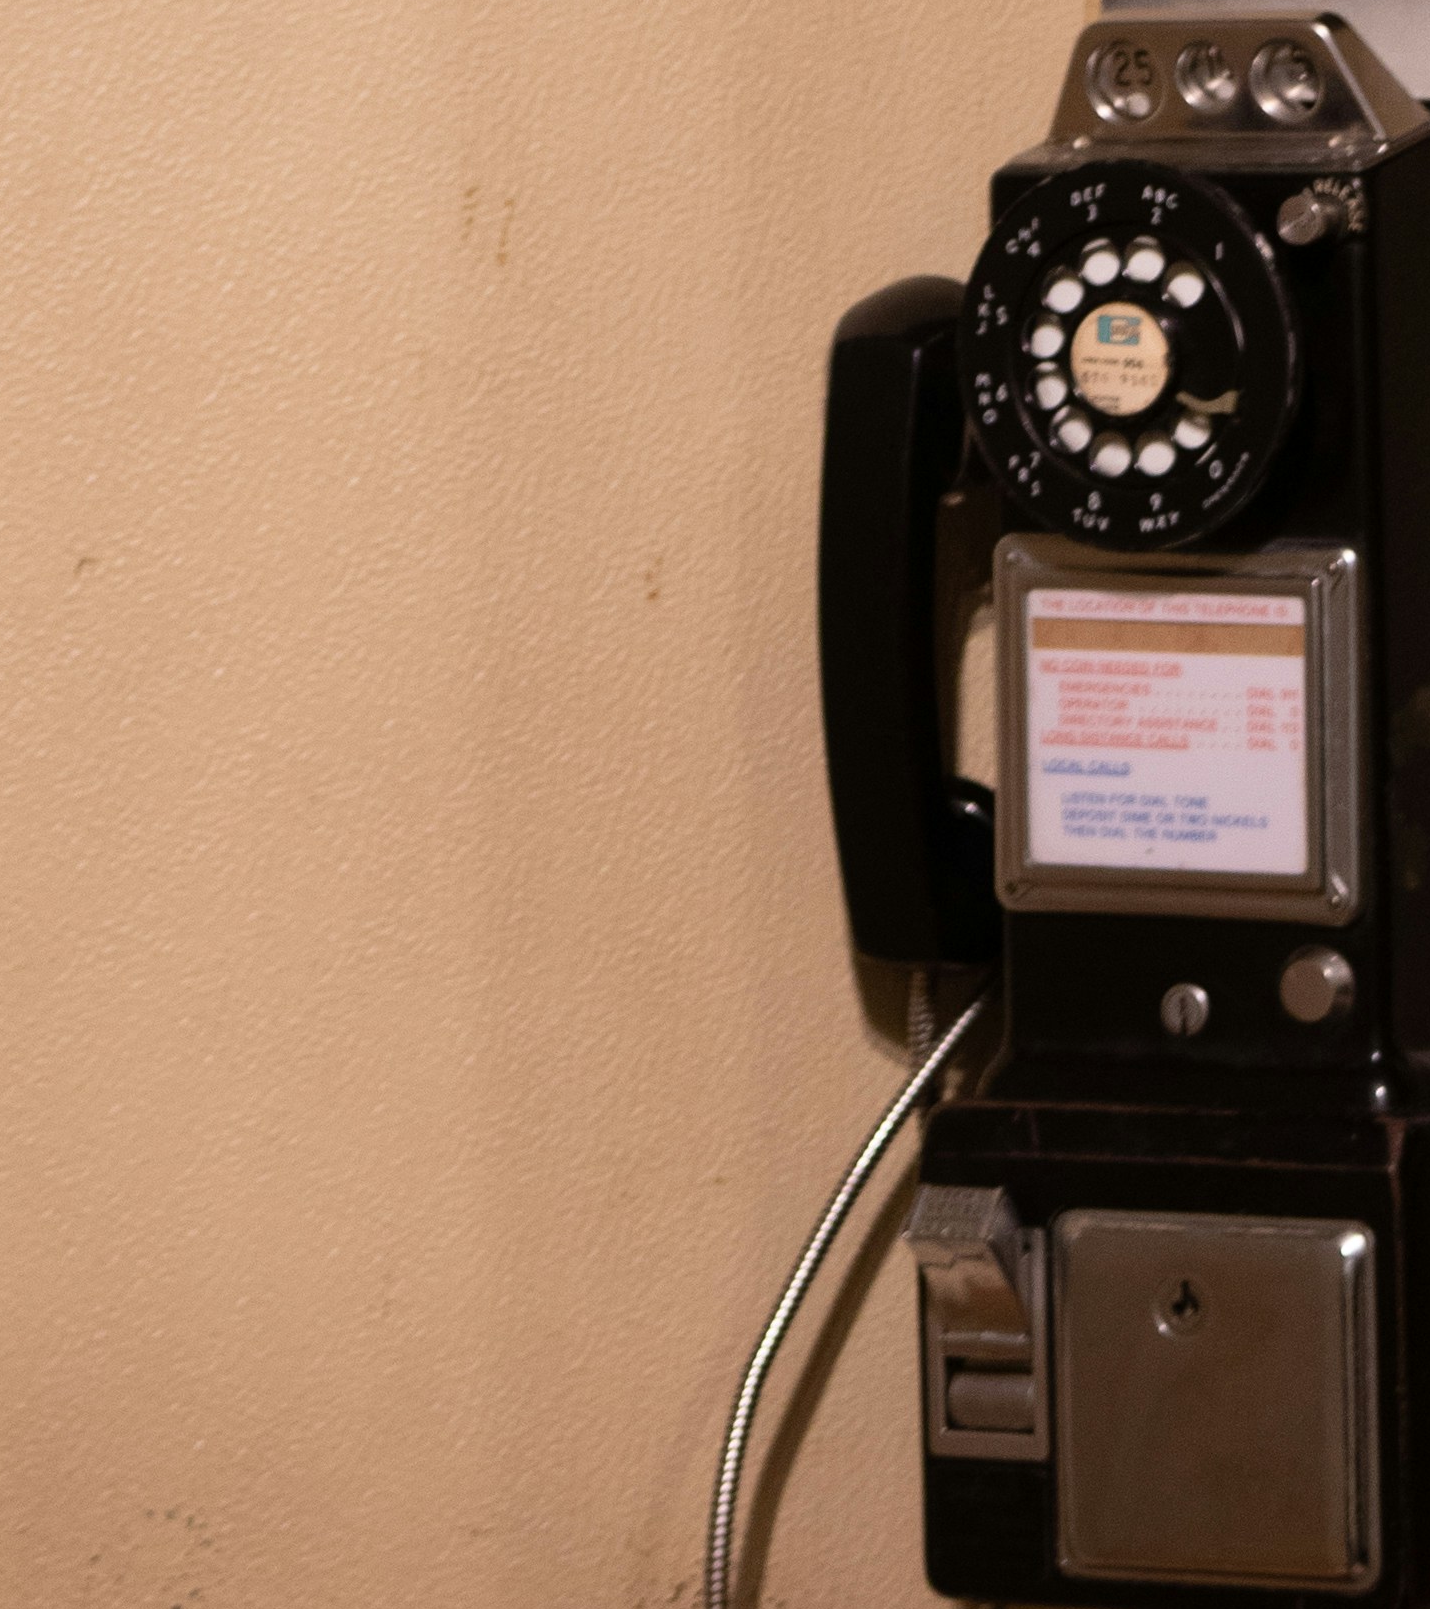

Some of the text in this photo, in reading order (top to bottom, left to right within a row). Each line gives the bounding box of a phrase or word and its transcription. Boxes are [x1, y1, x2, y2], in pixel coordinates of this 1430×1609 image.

[1115, 49, 1152, 86] 25
[1070, 183, 1106, 207] DEF
[1141, 185, 1178, 210] ABC
[1087, 203, 1098, 222] 3
[1151, 206, 1162, 225] 2
[1027, 240, 1041, 257] 4
[996, 305, 1008, 325] 5
[996, 382, 1008, 402] 6
[1030, 451, 1042, 469] 7
[1087, 491, 1101, 511] 8
[1149, 492, 1163, 512] 9
[1071, 507, 1110, 531] TUV
